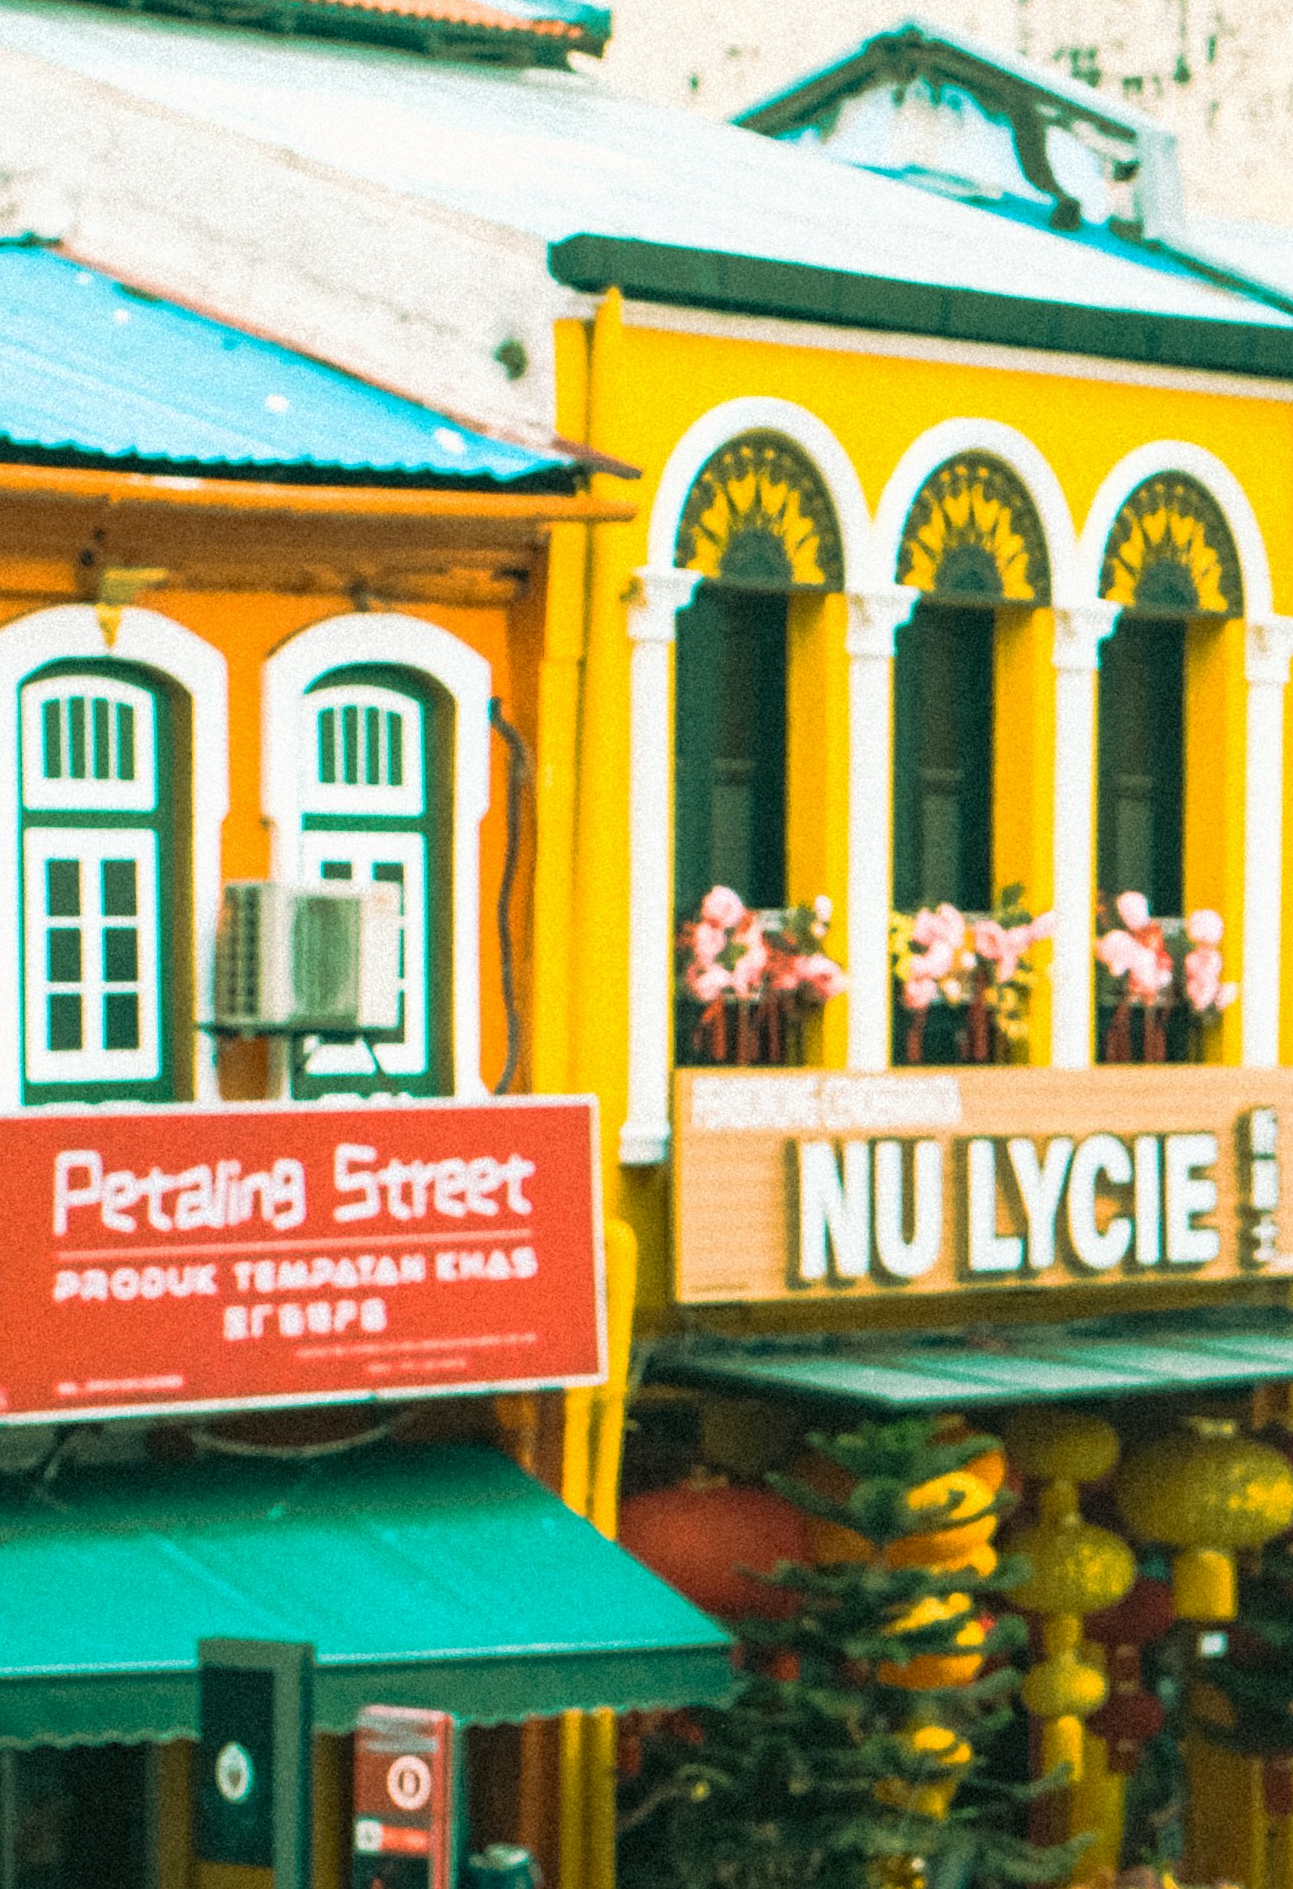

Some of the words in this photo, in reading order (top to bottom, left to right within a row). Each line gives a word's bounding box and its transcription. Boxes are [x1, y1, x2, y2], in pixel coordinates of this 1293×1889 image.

[52, 1148, 307, 1237] Petaling
[332, 1142, 537, 1223] Street
[796, 1138, 946, 1280] NU
[965, 1131, 1221, 1274] LYCIE
[52, 1263, 218, 1303] PRODUK
[232, 1253, 426, 1294] TEMPATAN
